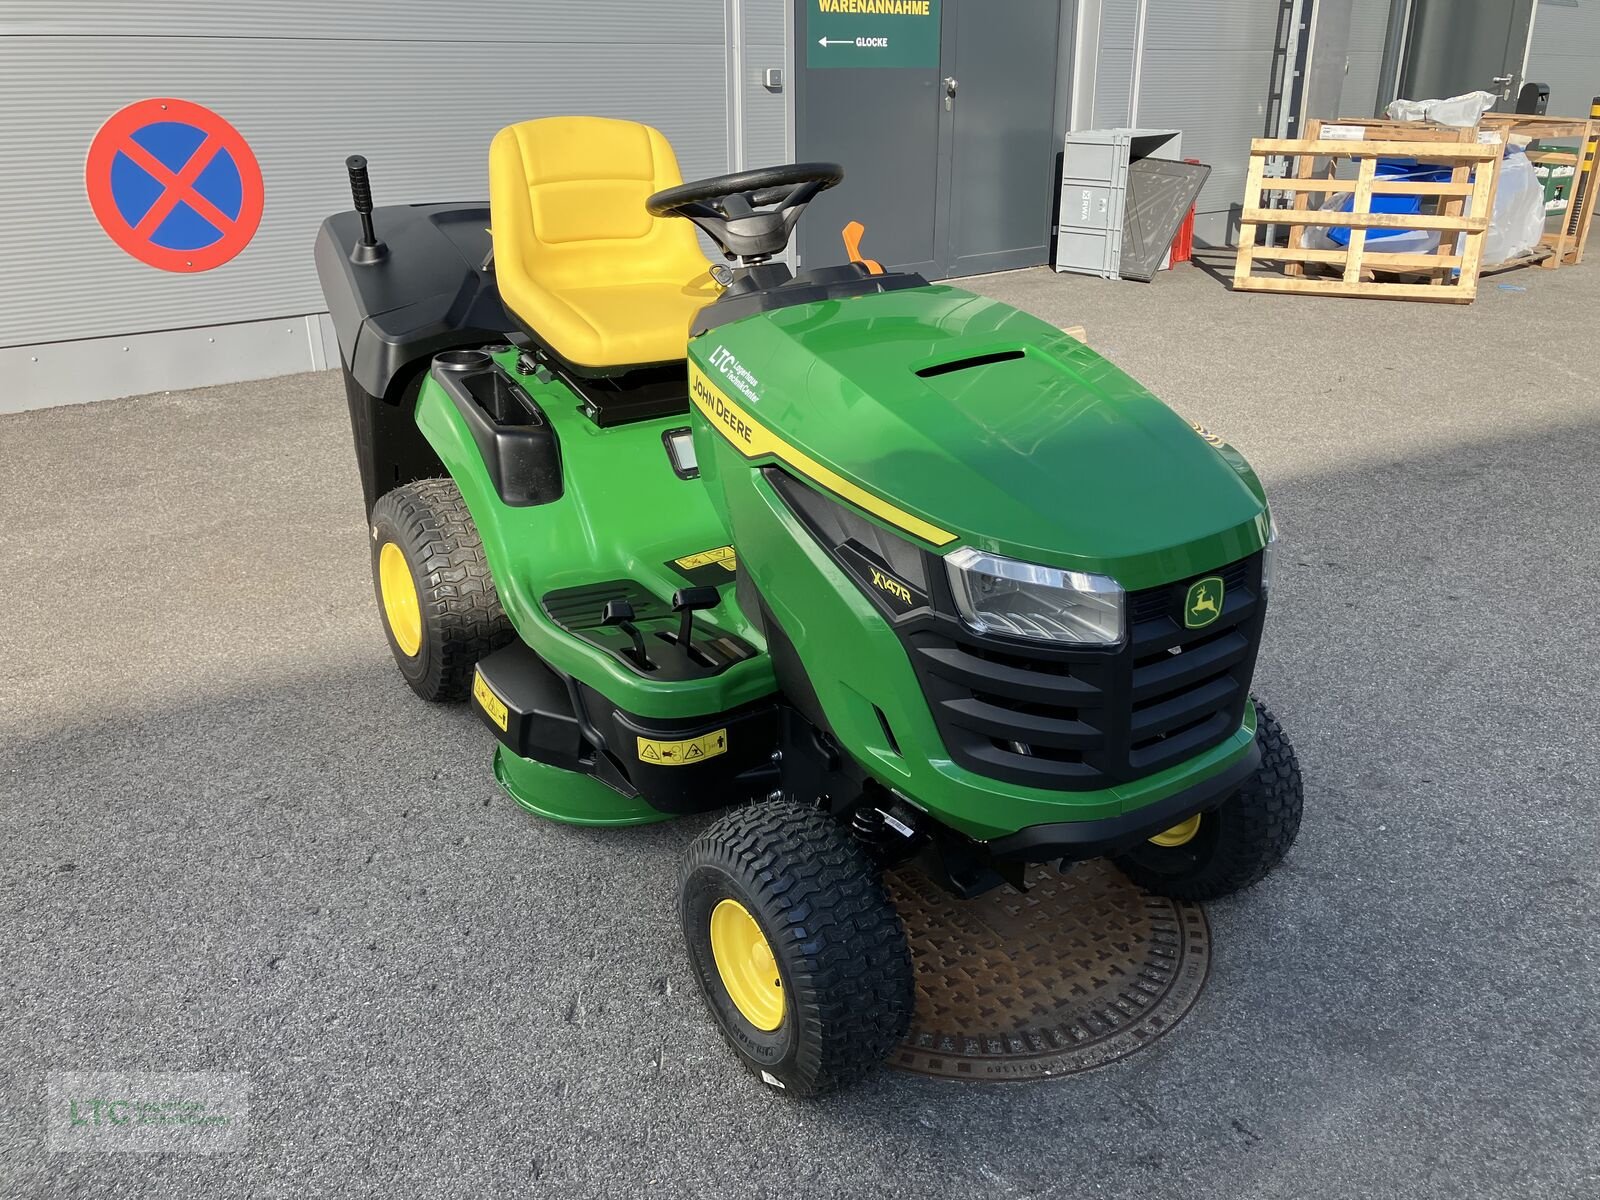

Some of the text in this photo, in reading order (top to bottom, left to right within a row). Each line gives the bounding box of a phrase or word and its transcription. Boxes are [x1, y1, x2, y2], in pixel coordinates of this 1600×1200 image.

[819, 0, 930, 15] WARENANNAHME
[855, 37, 888, 47] GLOCKE
[708, 345, 736, 373] LTC
[726, 369, 760, 403] TechnikCenter
[733, 361, 759, 387] Lagerhaus
[693, 375, 753, 444] JOHN DEERE
[870, 567, 912, 605] X147R
